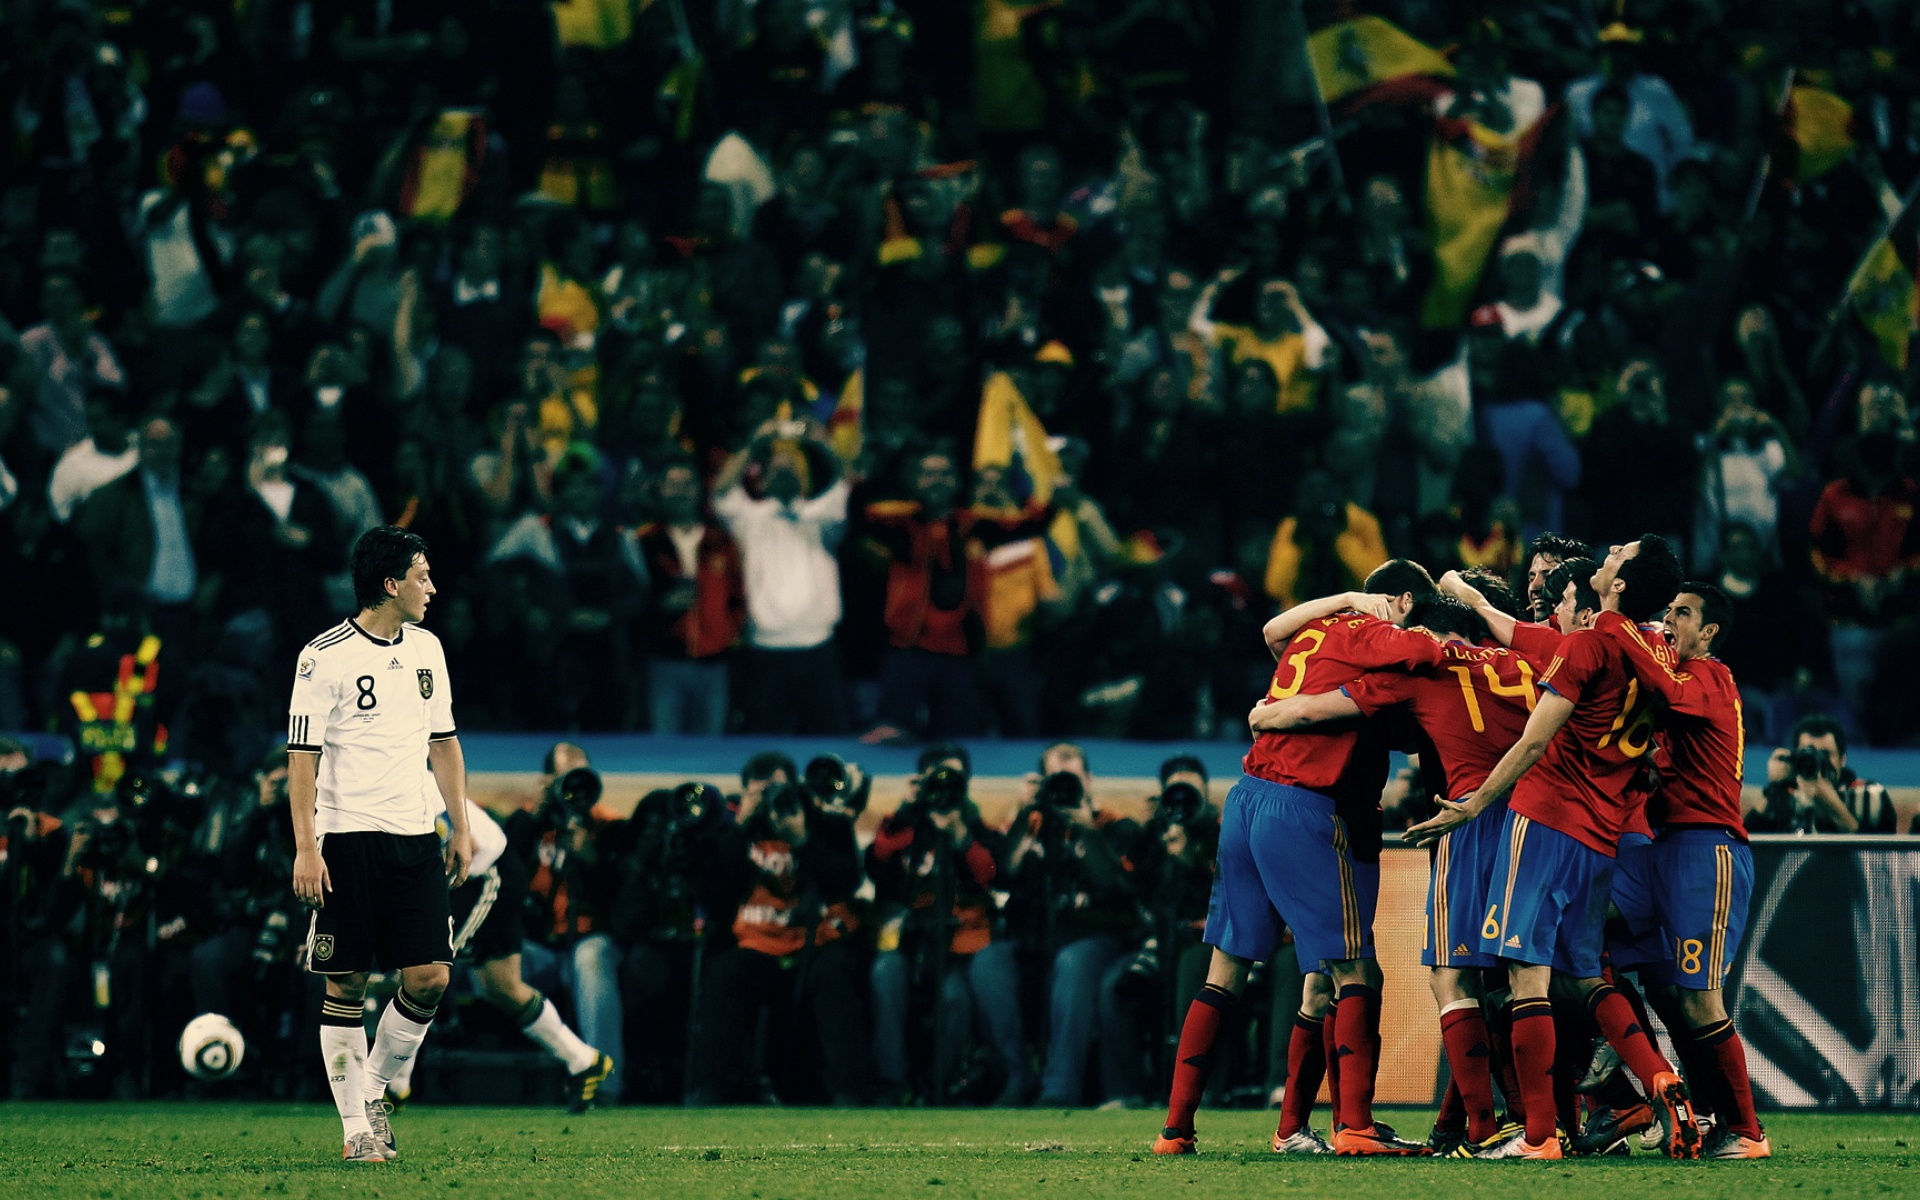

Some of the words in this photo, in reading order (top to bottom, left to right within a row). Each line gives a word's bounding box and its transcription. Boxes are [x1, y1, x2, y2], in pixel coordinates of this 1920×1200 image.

[356, 674, 377, 710] 8
[1271, 628, 1326, 700] 3
[1447, 659, 1537, 733] 14
[1596, 677, 1653, 759] 16
[1675, 936, 1704, 975] 18
